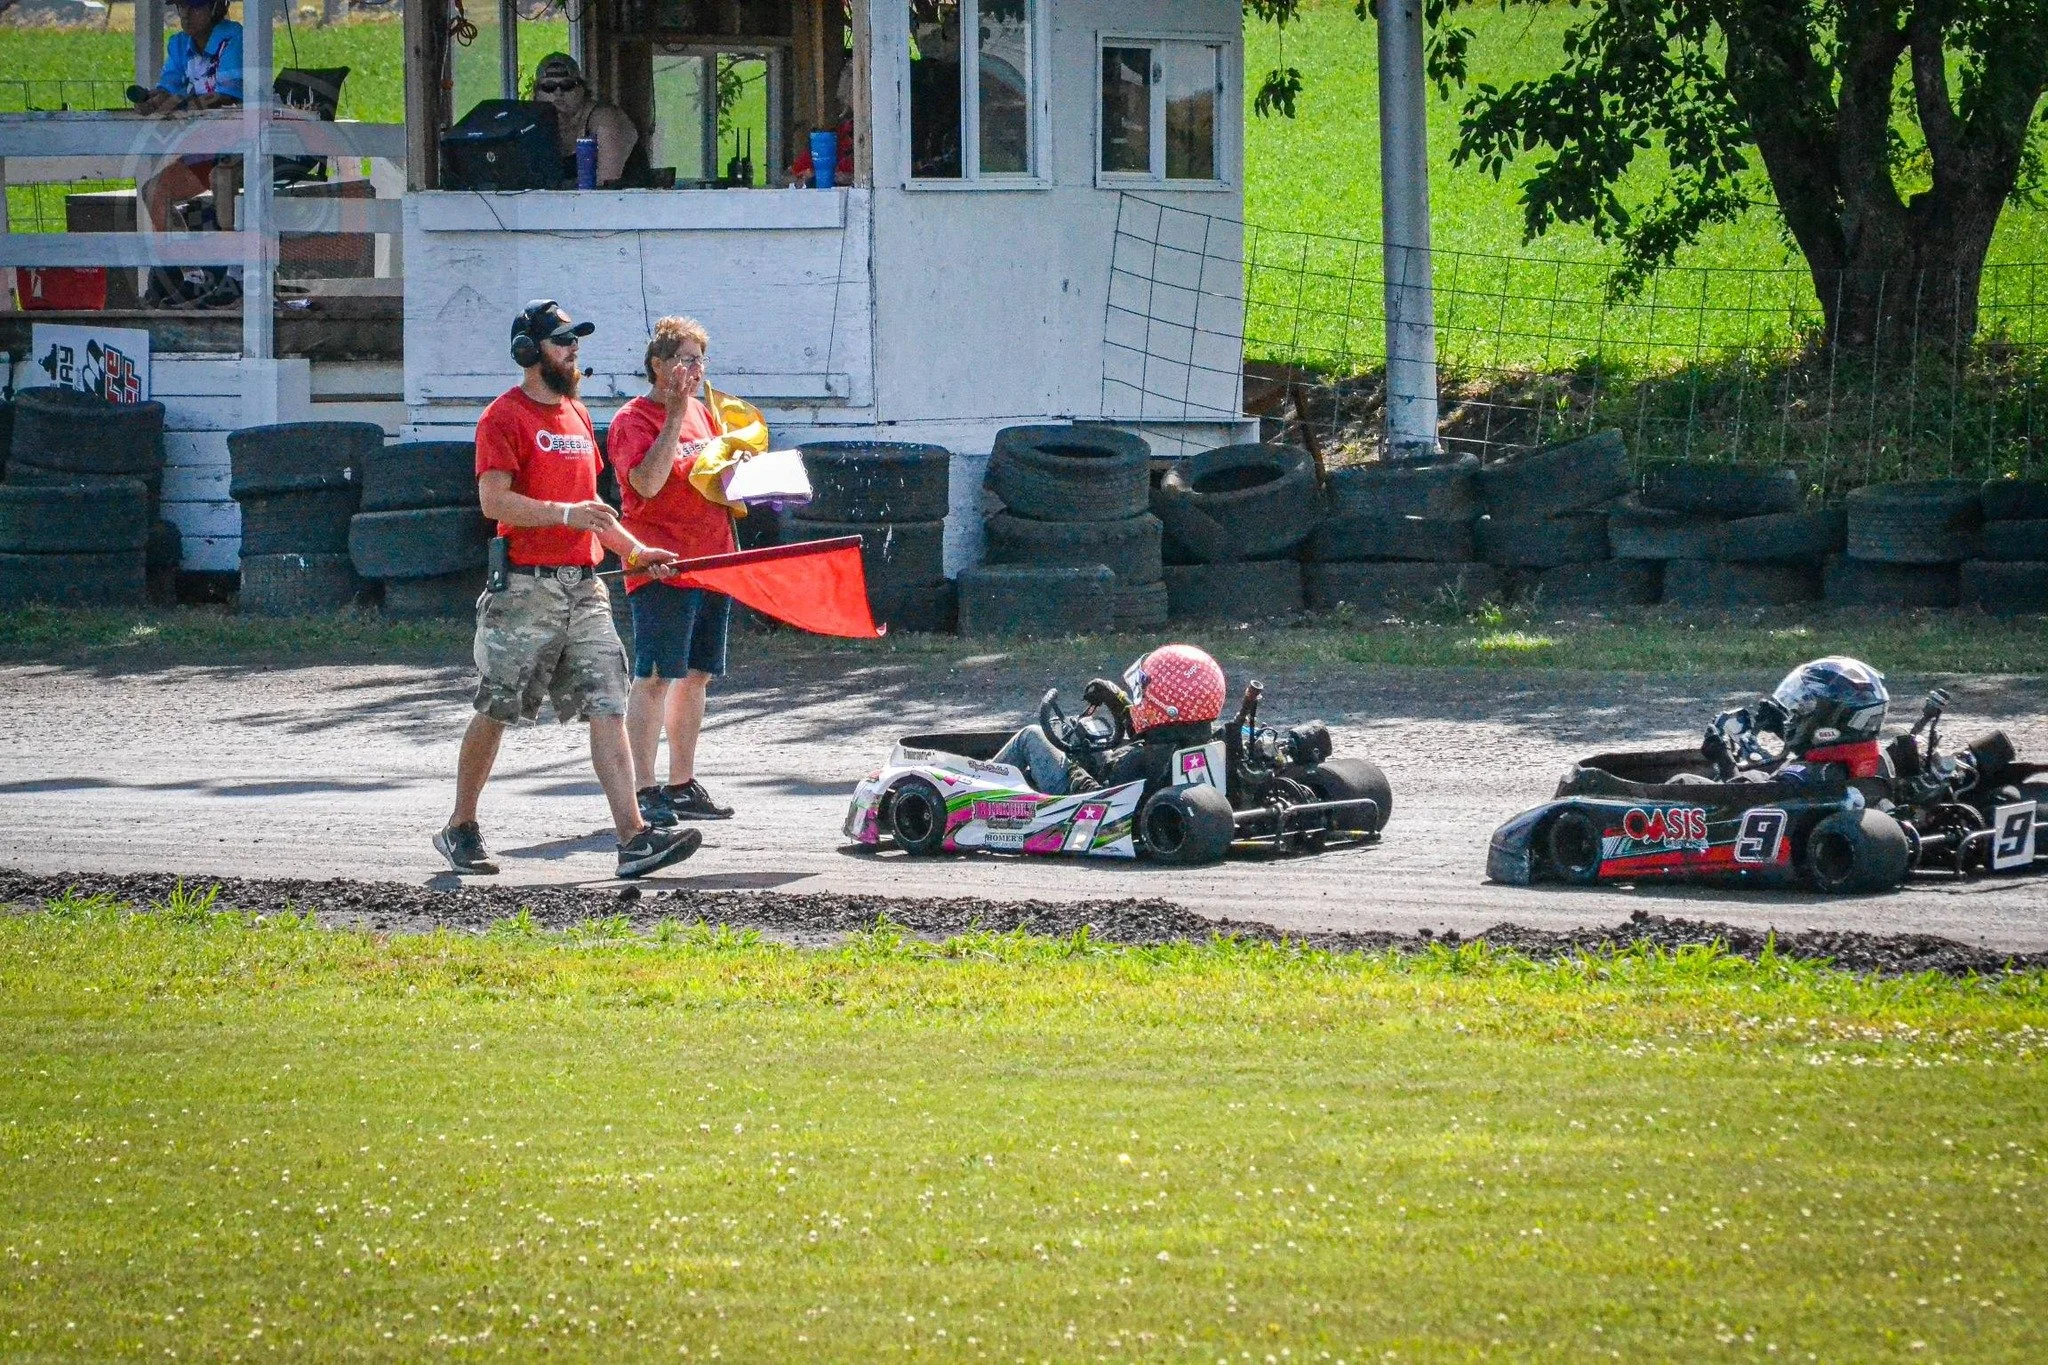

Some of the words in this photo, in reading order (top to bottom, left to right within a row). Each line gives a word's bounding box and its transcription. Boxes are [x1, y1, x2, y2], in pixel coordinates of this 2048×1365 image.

[1061, 800, 1112, 852] 1
[1624, 808, 1708, 842] OASIS
[1735, 808, 1788, 863] 9
[1997, 811, 2034, 859] 9
